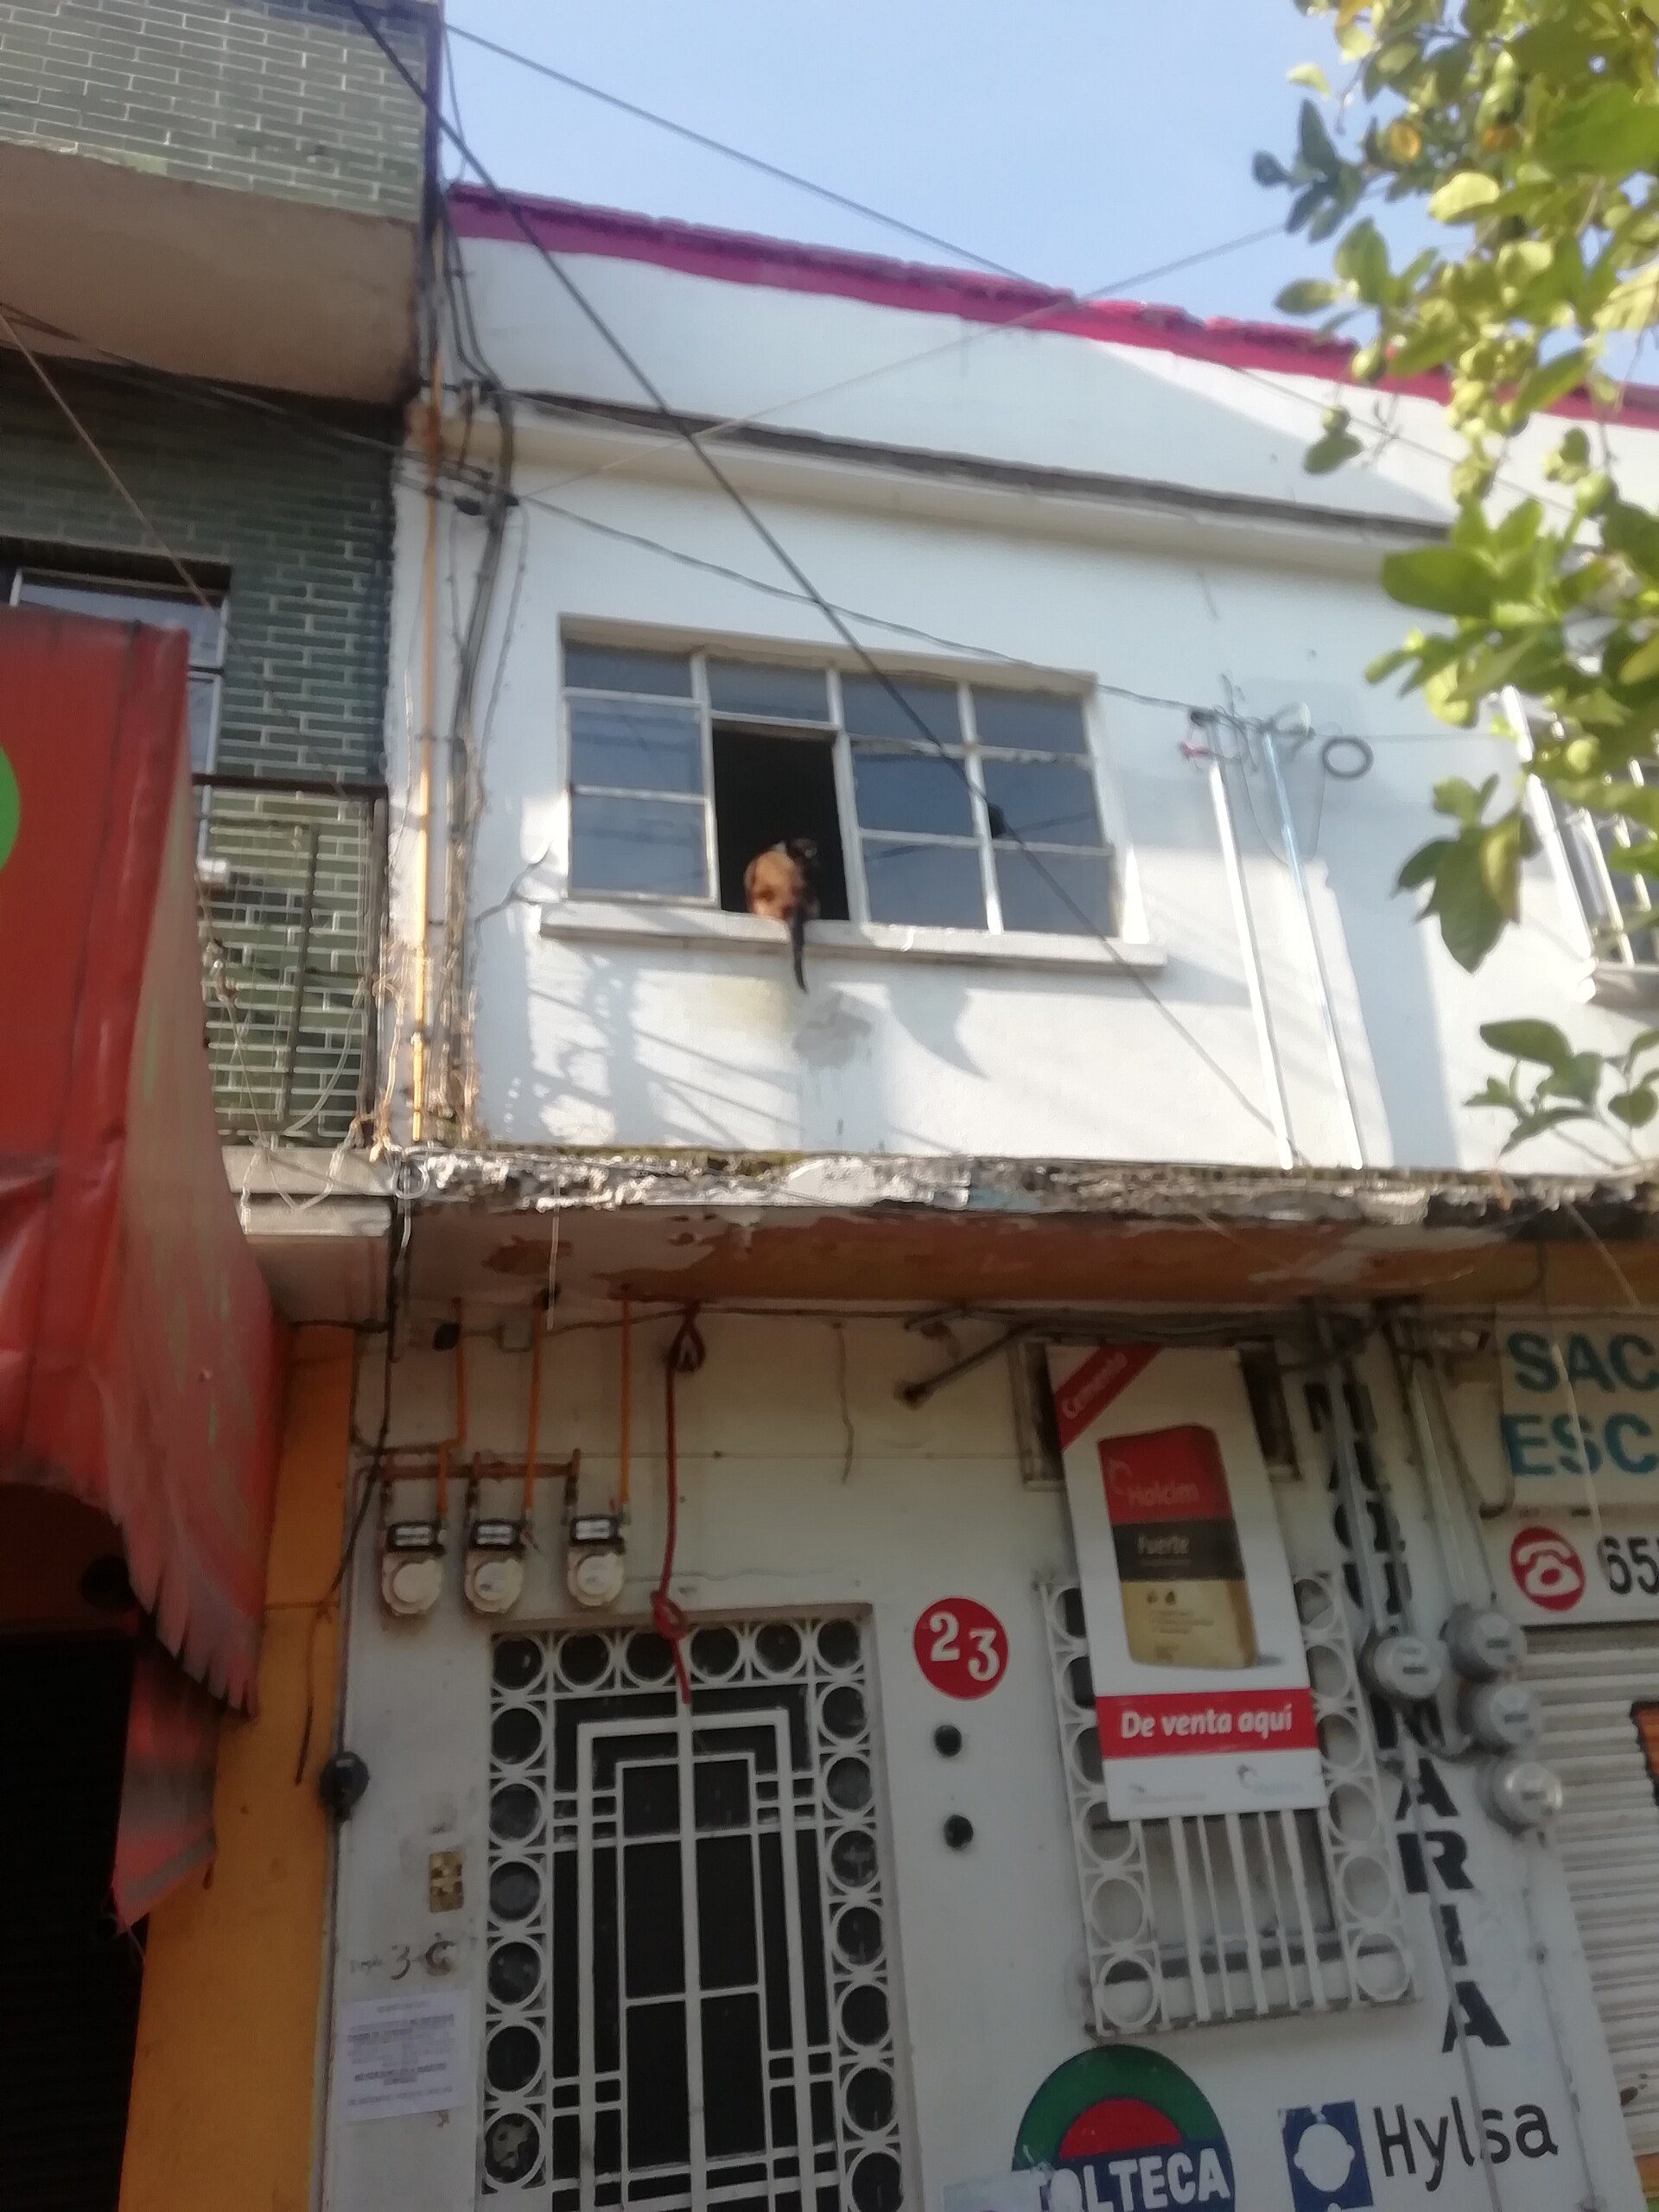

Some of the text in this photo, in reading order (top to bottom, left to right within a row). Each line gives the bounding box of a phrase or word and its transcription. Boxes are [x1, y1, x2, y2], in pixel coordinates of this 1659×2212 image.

[1506, 1330, 1659, 1394] SAC
[1501, 1412, 1659, 1477] ESC
[1137, 1534, 1190, 1555] Fuerte
[1597, 1535, 1659, 1595] 65
[929, 1610, 1000, 1681] 23
[1121, 1703, 1293, 1739] De venta aquí
[1304, 1381, 1510, 2052] MAQUNARIA
[1374, 2094, 1559, 2192] Hylsa
